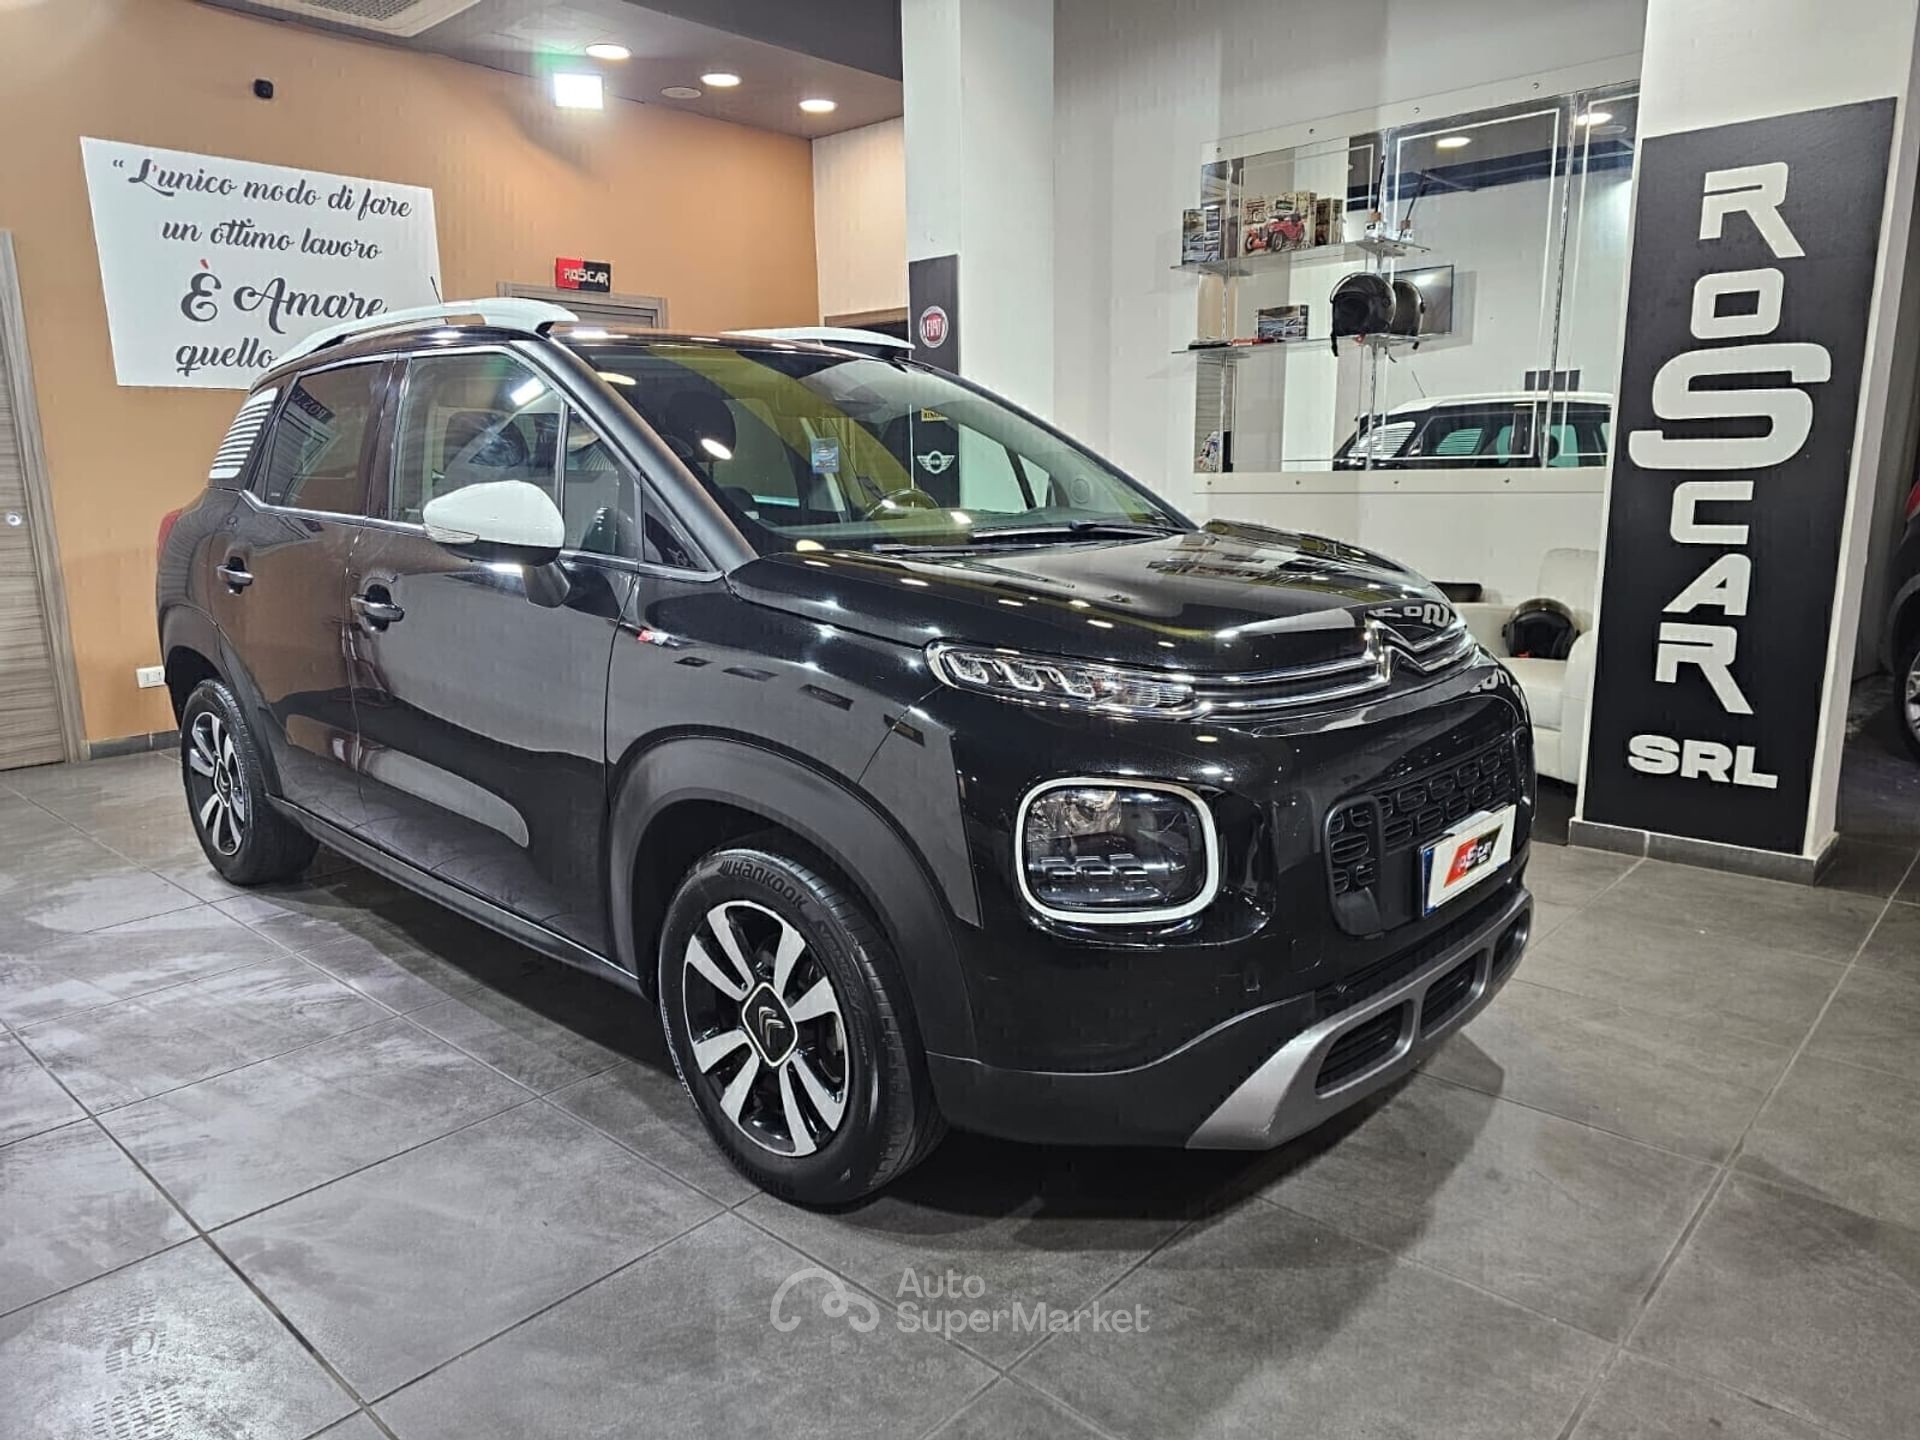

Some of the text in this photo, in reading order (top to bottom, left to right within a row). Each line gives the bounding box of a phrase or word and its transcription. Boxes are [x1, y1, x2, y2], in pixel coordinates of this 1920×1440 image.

[243, 179, 321, 206] modo
[327, 184, 355, 211] di
[357, 187, 412, 222] fare
[162, 217, 383, 260] un ottimo lavoro
[180, 258, 388, 335] È Amare
[175, 337, 278, 377] quello
[1627, 734, 1778, 789] SRL
